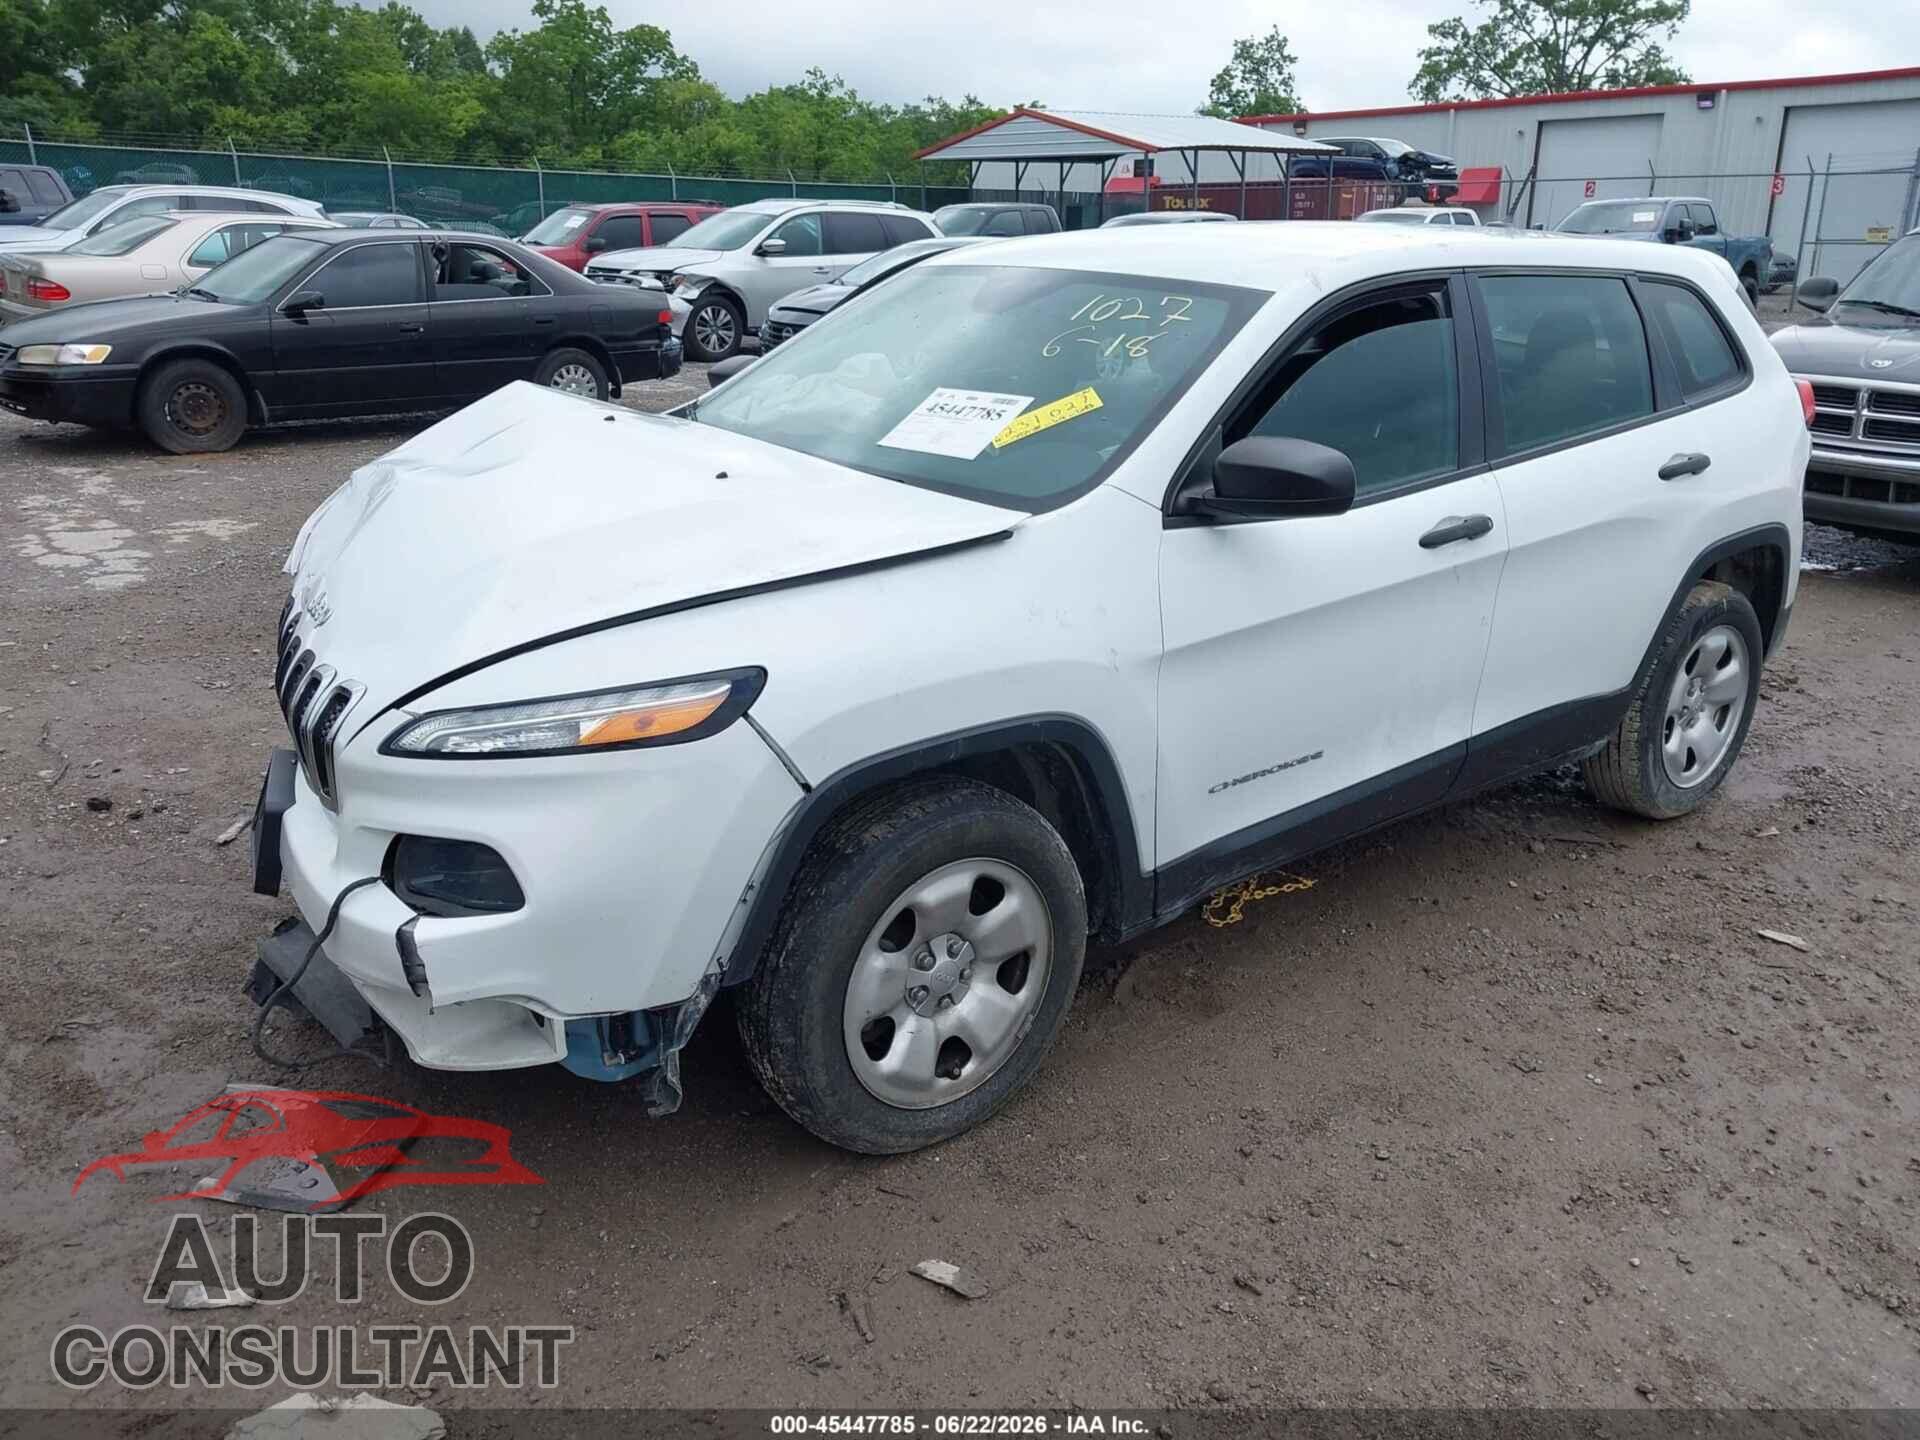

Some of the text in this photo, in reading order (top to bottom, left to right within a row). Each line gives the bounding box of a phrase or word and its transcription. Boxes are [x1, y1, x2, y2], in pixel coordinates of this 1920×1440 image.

[1773, 179, 1782, 193] 3
[926, 402, 1009, 421] 45447785
[1208, 750, 1324, 793] CHEROKEE
